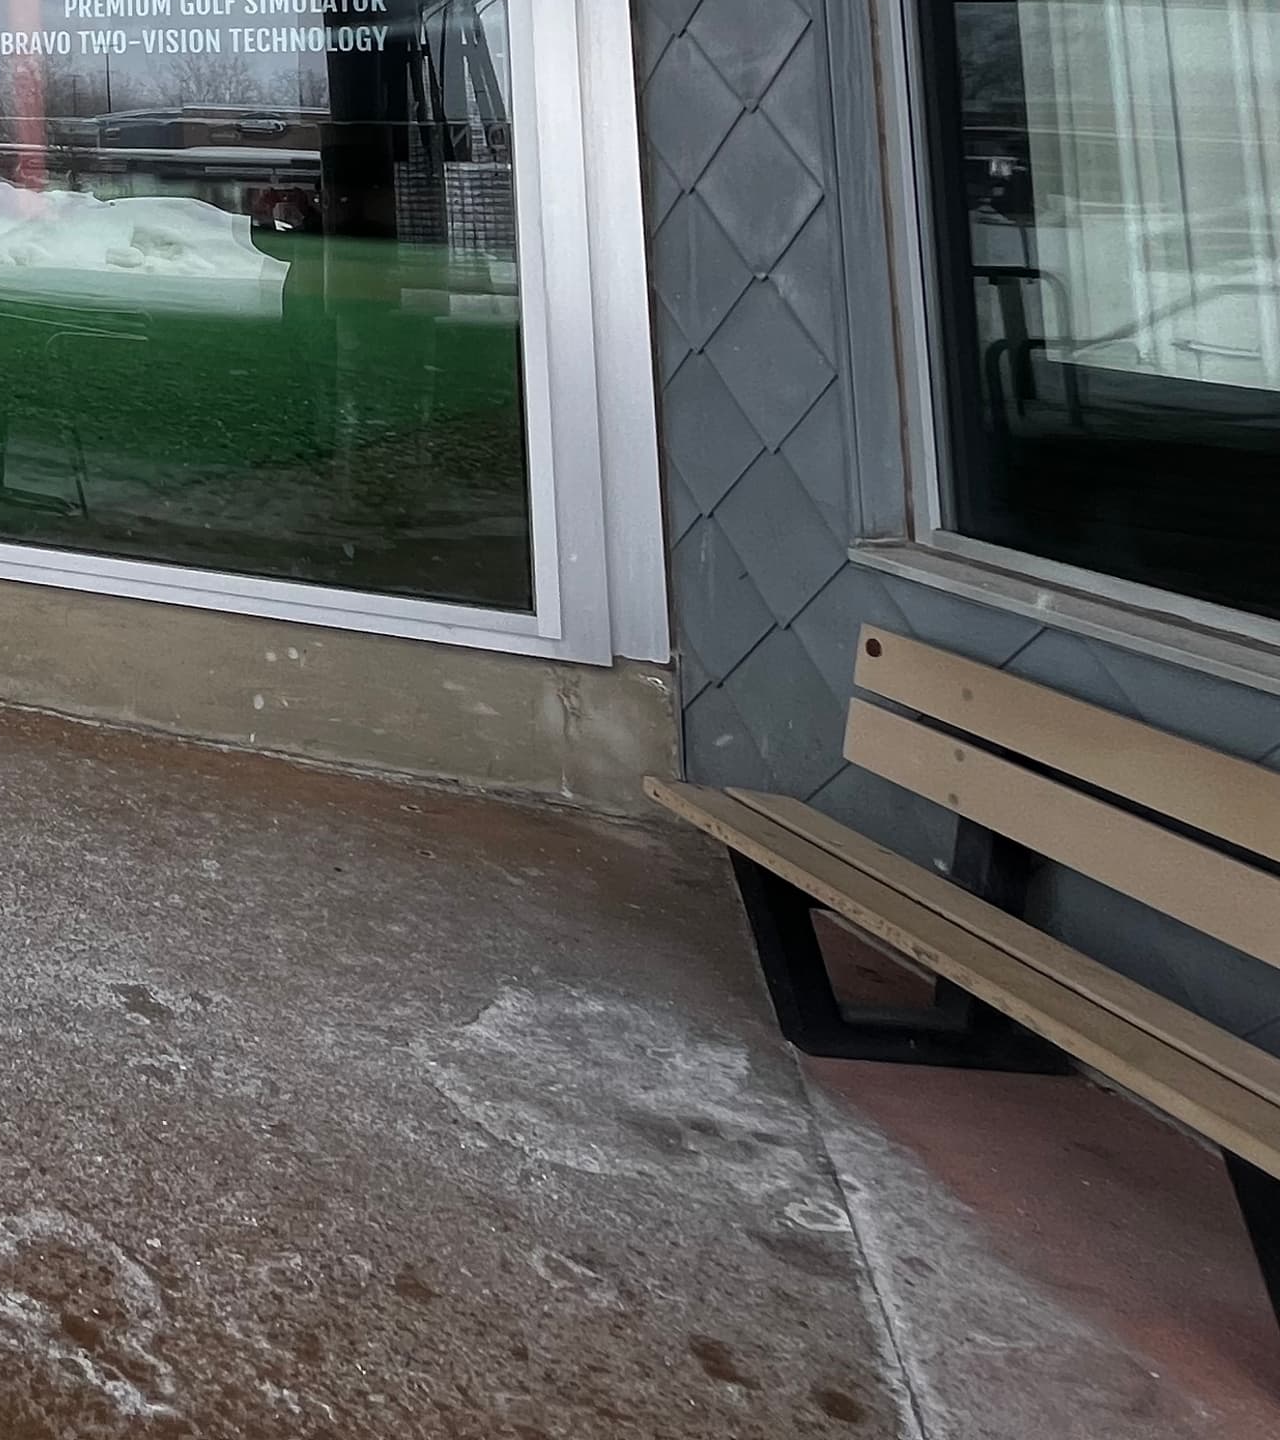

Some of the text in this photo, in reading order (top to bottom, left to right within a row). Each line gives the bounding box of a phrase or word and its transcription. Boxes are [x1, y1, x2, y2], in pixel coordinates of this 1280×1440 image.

[0, 30, 71, 56] BRAVO
[77, 27, 221, 55] TWO-VISION
[229, 25, 389, 53] TECHNOLOGY
